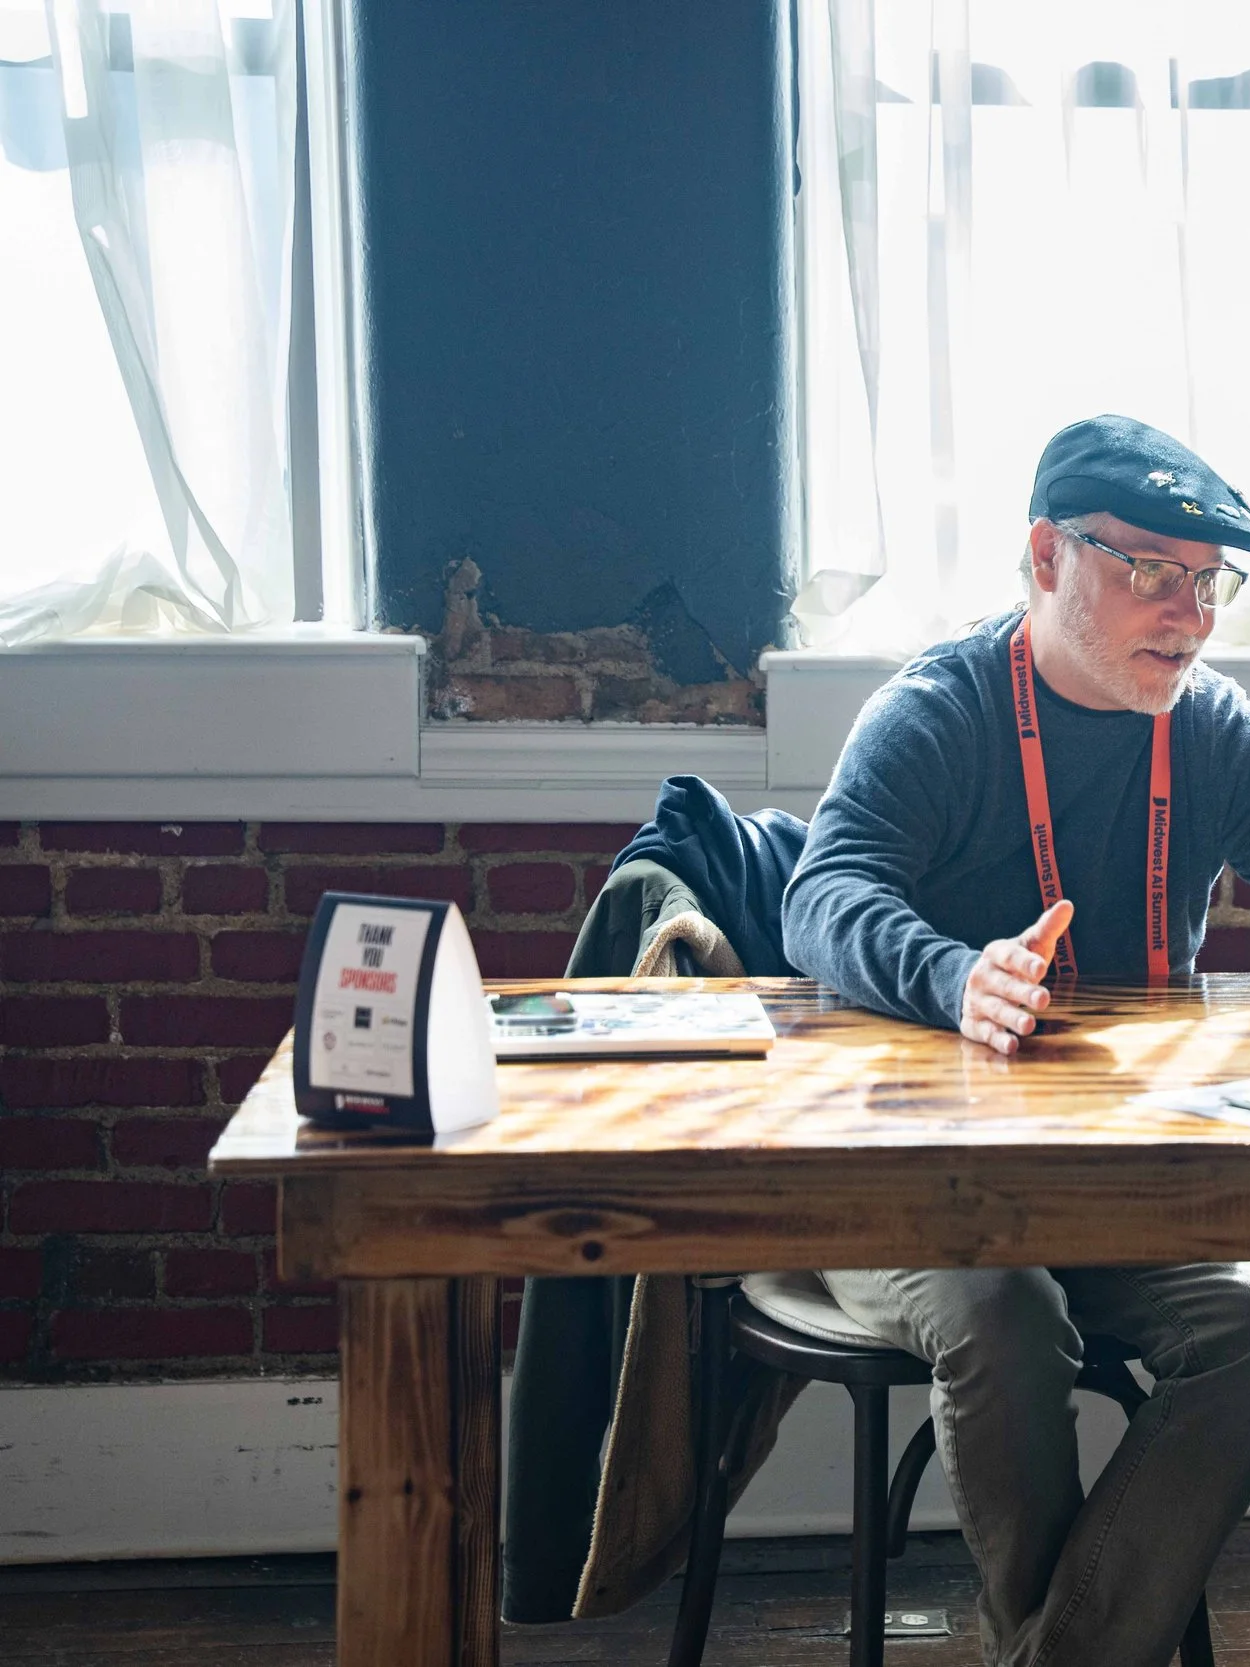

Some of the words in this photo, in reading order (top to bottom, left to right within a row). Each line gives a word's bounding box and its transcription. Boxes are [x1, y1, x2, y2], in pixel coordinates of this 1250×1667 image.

[1014, 649, 1025, 662] AI
[1016, 664, 1032, 727] Midwest
[1153, 809, 1167, 871] Midwest
[1034, 823, 1053, 882] Summit
[1043, 885, 1057, 899] AI
[1152, 874, 1163, 888] AI
[1152, 891, 1165, 950] Summit
[357, 923, 396, 945] THANK
[361, 947, 385, 968] YOU
[339, 968, 398, 994] SPONSORS
